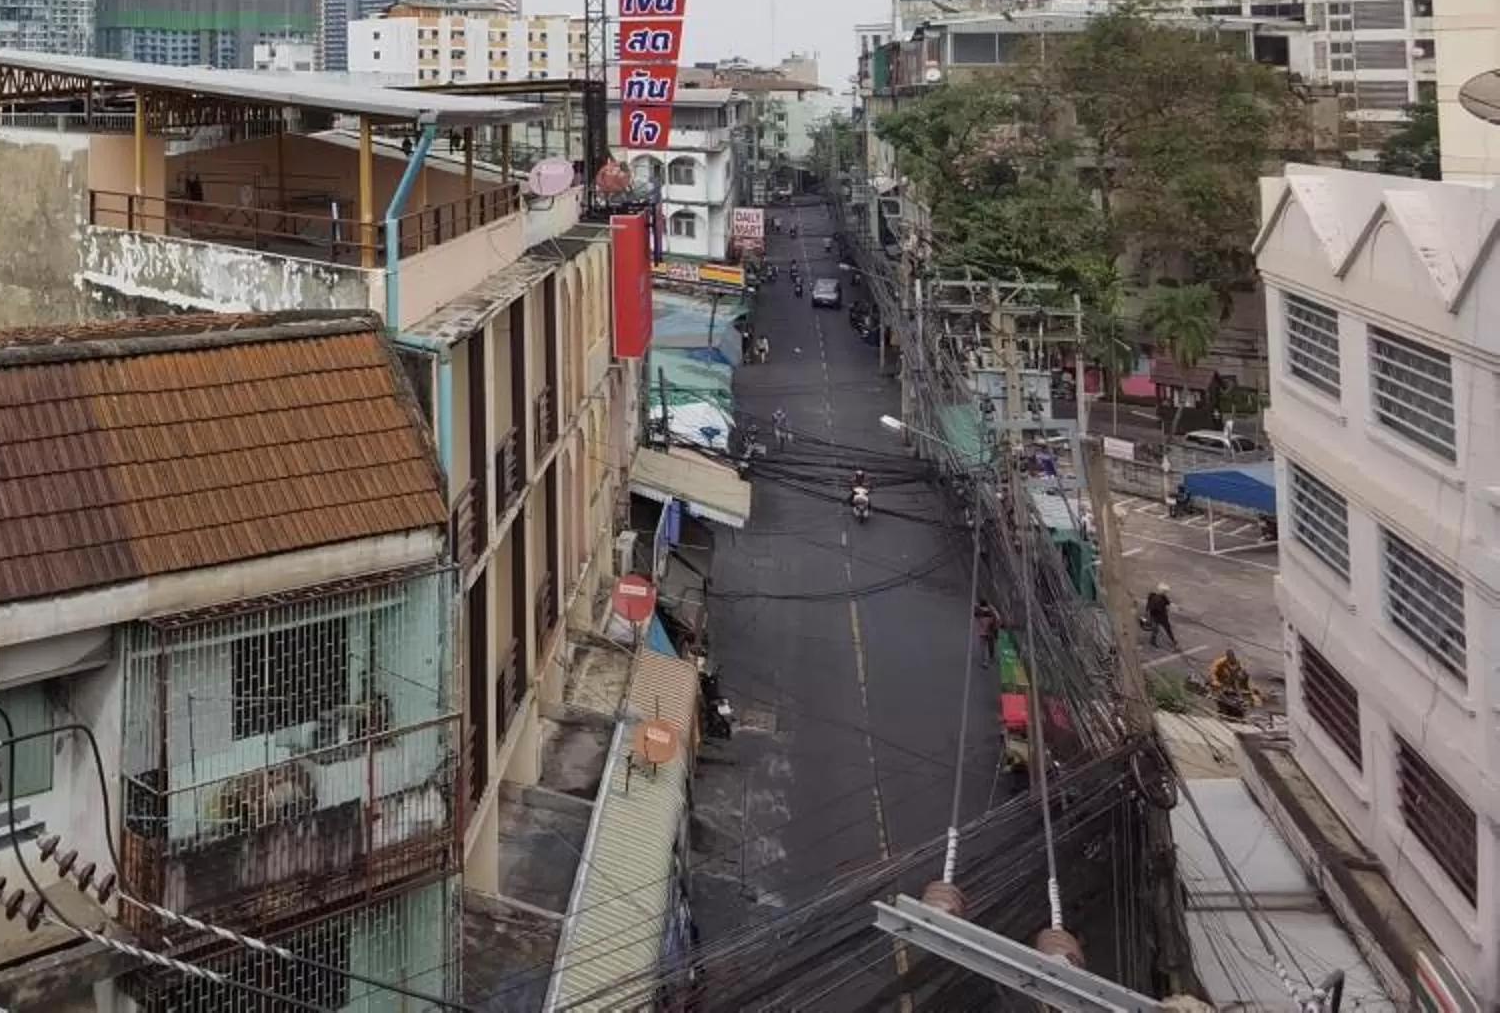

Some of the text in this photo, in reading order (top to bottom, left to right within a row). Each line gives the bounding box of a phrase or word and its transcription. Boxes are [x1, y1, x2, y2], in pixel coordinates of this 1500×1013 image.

[627, 29, 672, 52] สด
[630, 111, 660, 143] ใจ
[735, 223, 762, 235] MART
